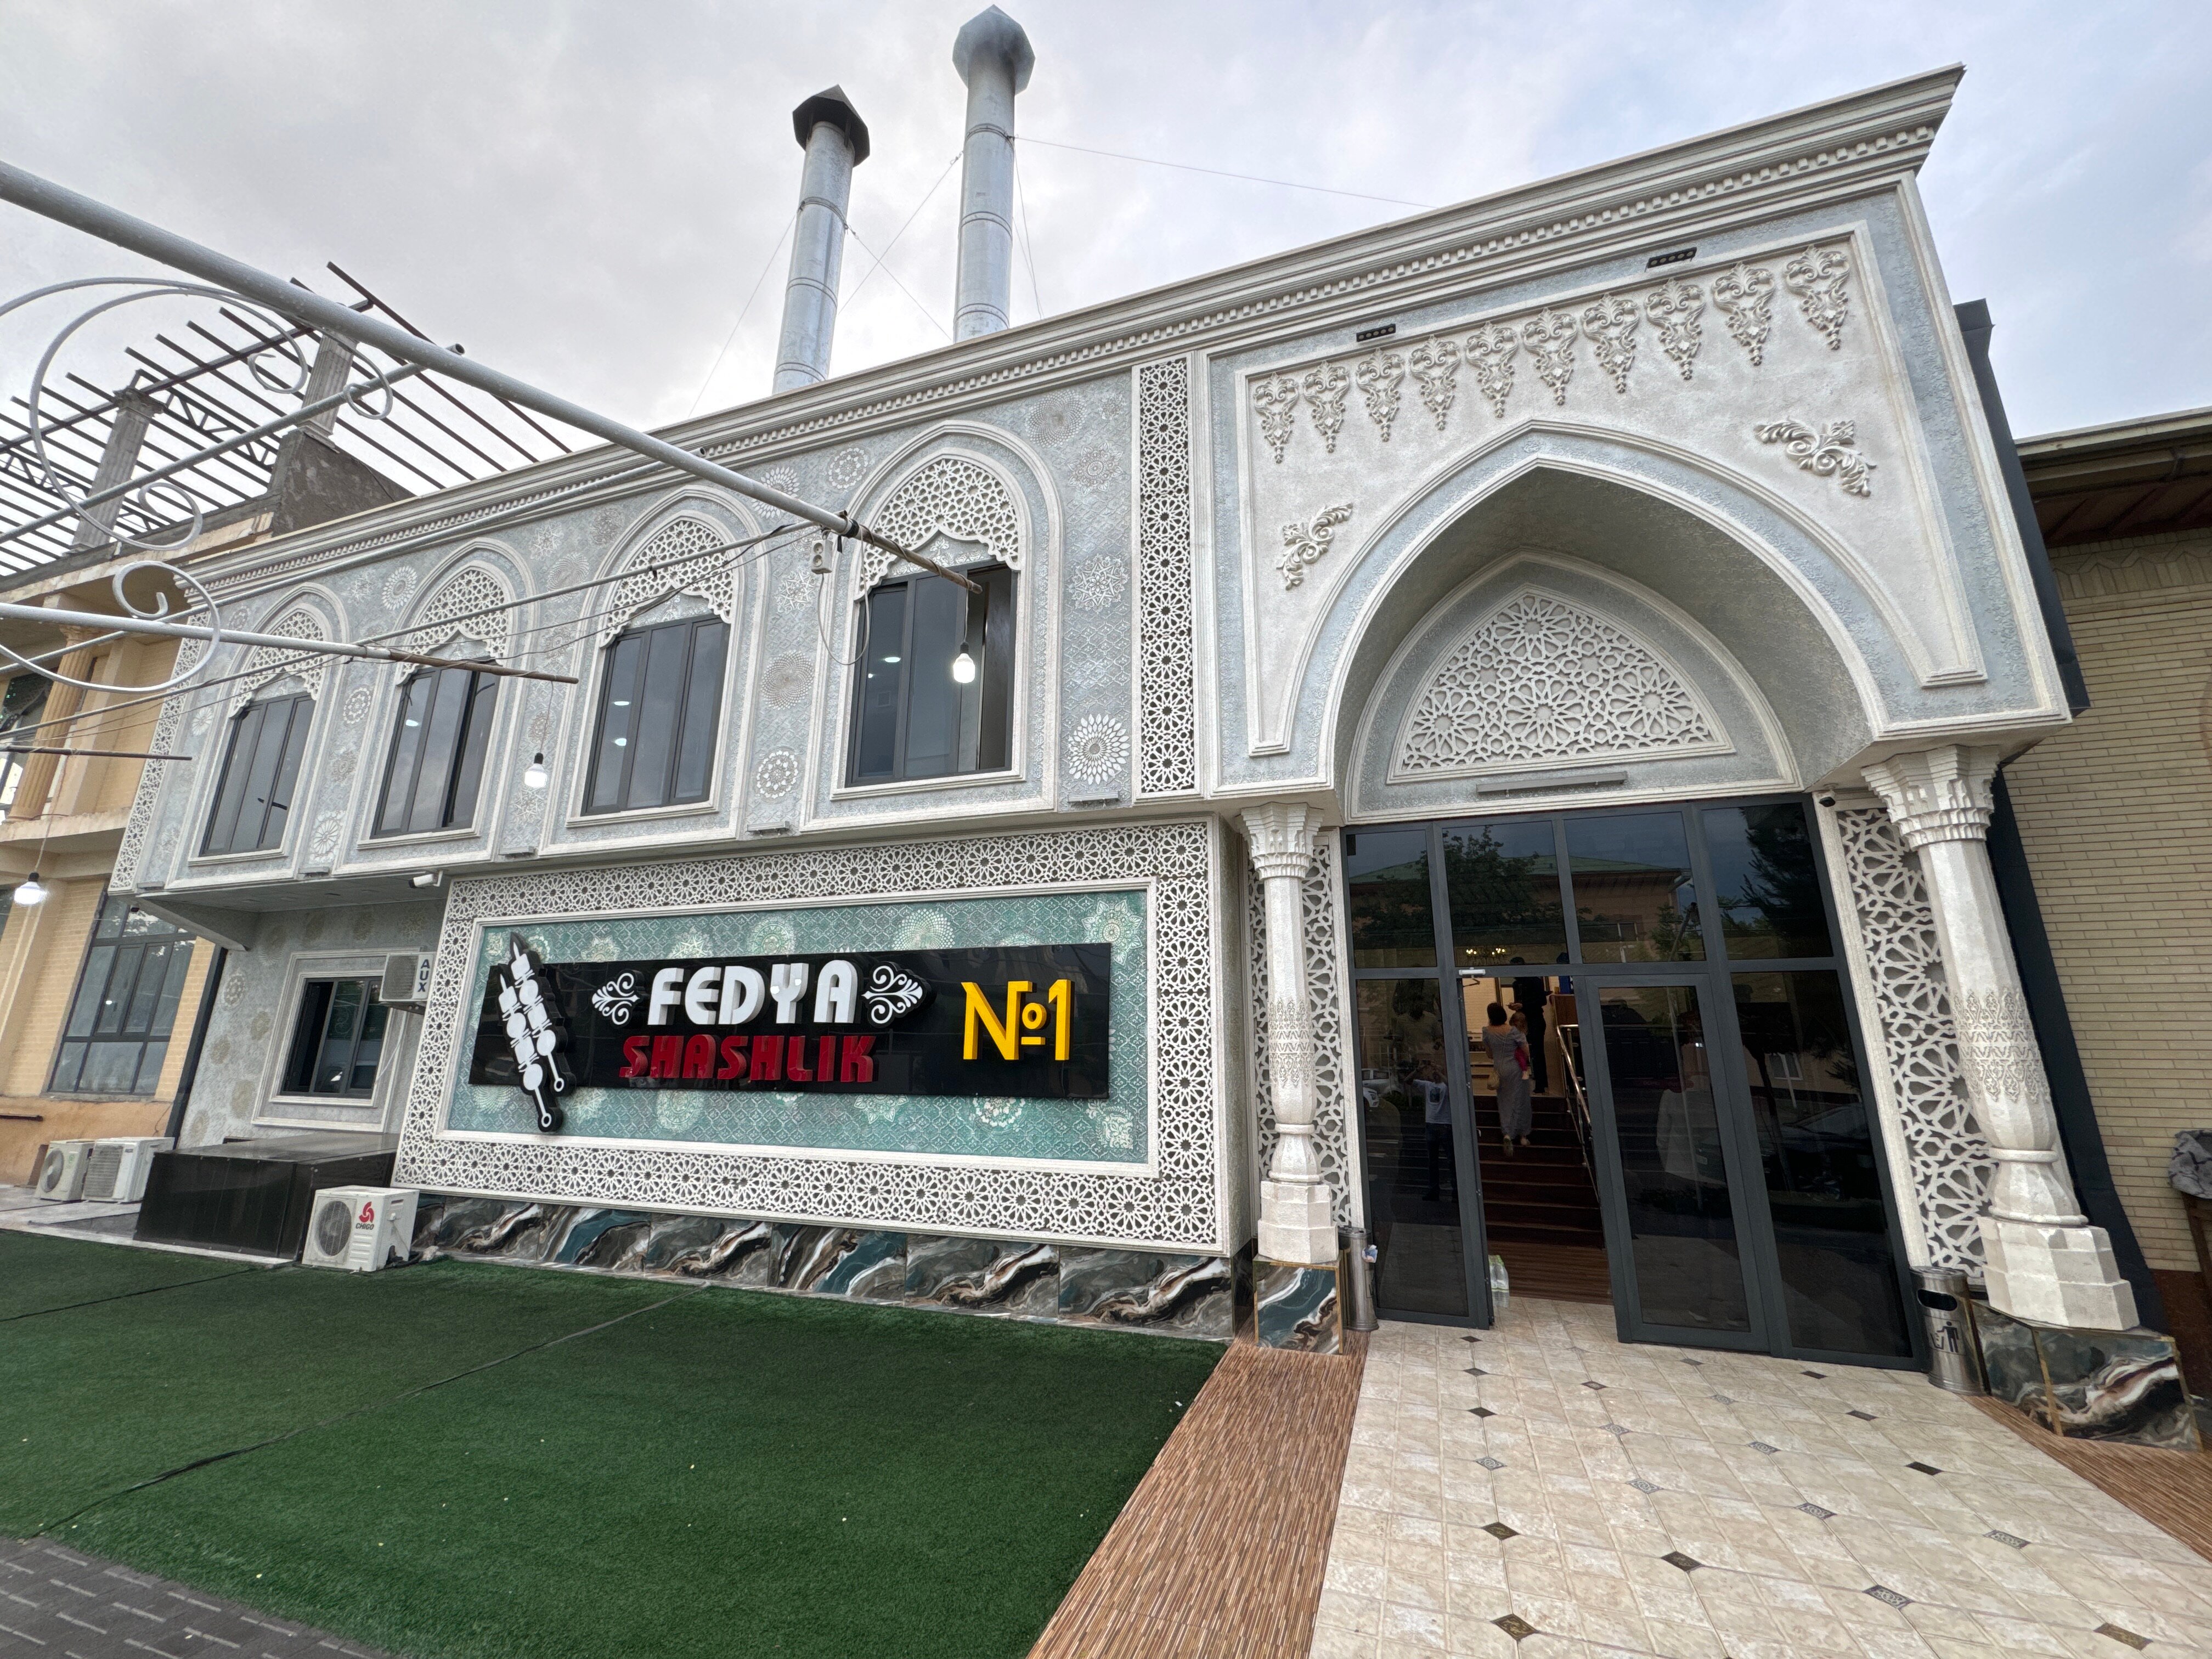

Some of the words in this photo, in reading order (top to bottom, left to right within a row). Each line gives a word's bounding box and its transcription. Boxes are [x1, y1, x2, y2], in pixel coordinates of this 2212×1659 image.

[417, 959, 430, 992] AUX
[647, 960, 858, 1025] FEDYA
[619, 1035, 876, 1082] SHASHLIK
